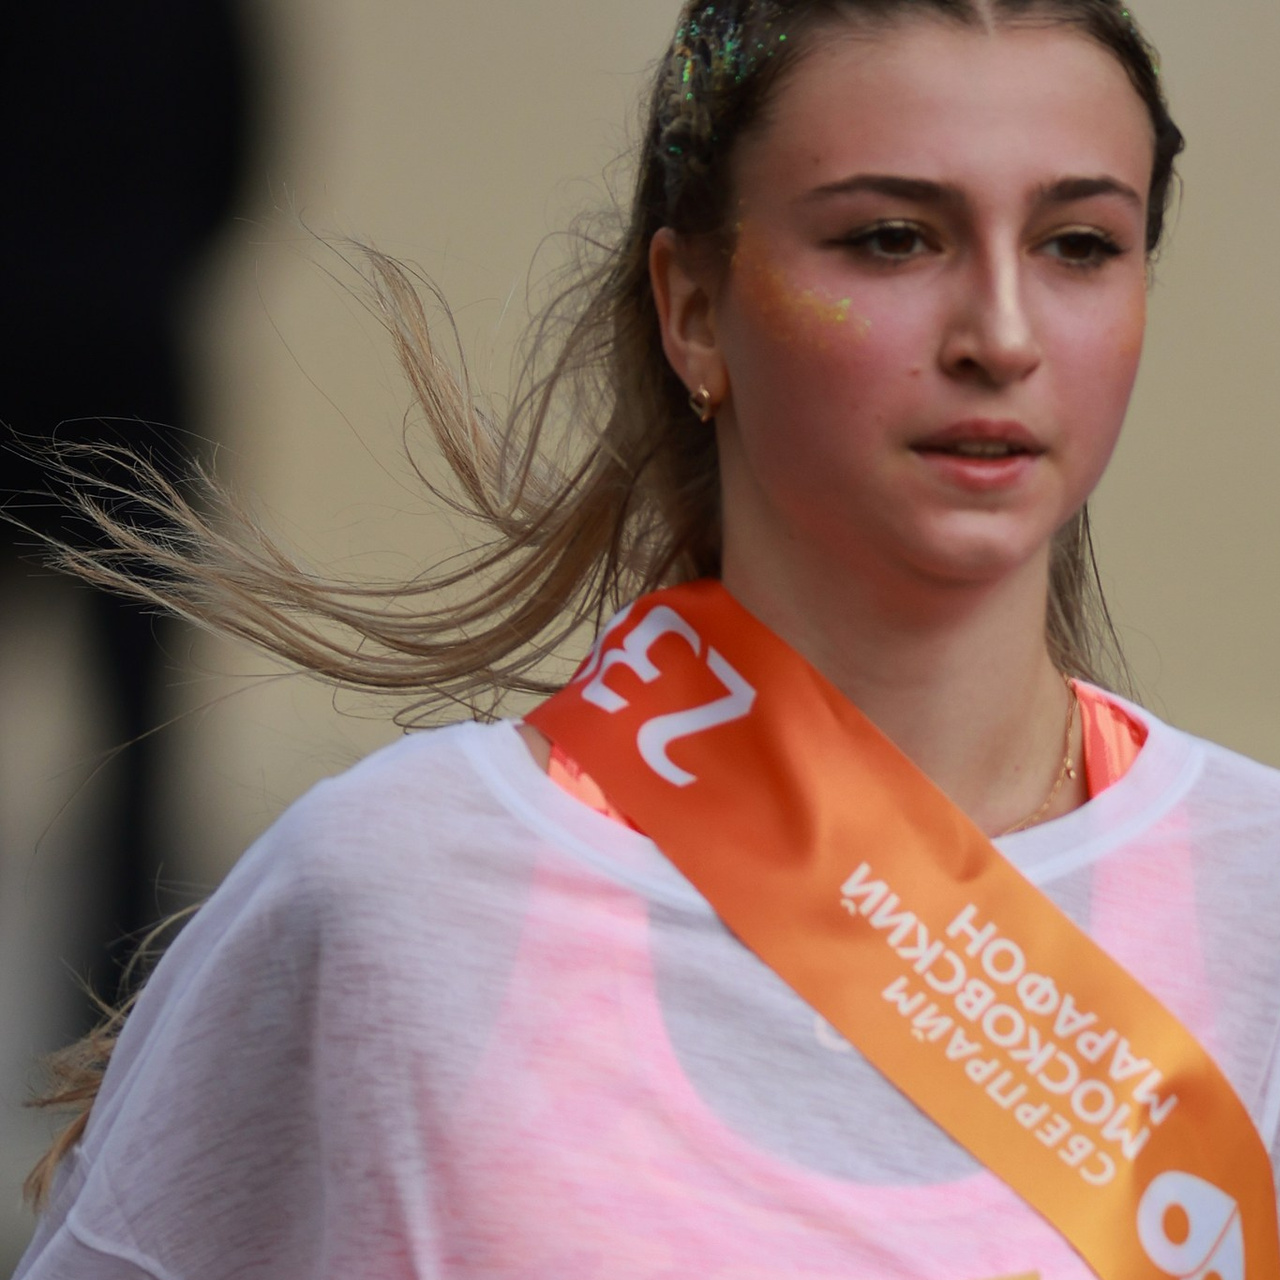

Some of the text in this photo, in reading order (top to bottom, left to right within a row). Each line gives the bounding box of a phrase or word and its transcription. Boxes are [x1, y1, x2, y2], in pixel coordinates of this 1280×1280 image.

[840, 861, 1150, 1161] МОСКОВСКИЙ
[881, 975, 1117, 1186] СБЕРПРАЙМ
[946, 903, 1178, 1125] МАРАФОН
